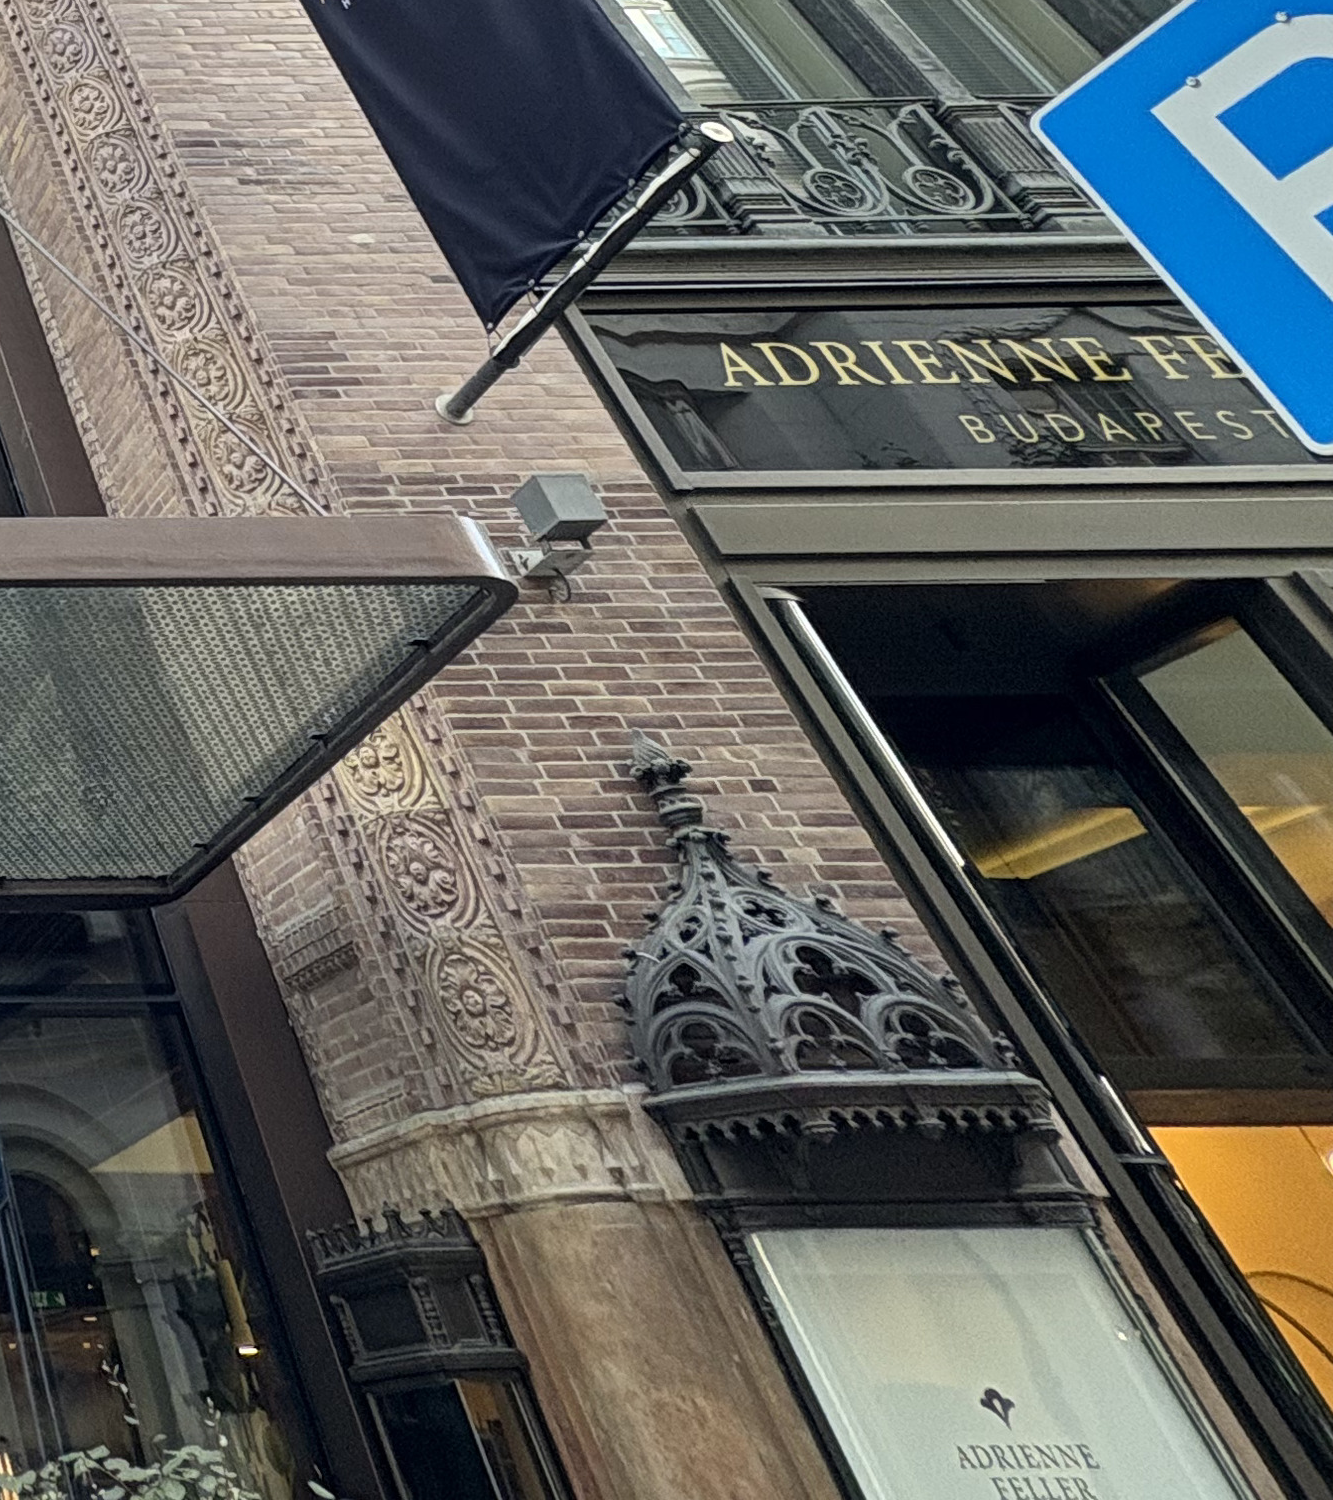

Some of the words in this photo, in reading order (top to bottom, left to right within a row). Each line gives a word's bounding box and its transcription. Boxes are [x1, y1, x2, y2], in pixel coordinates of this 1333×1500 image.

[718, 337, 1132, 388] ADRIENNE
[957, 408, 1291, 445] BUDAPEST
[954, 1443, 1101, 1470] ADRIENNE
[989, 1476, 1099, 1500] FELLER
